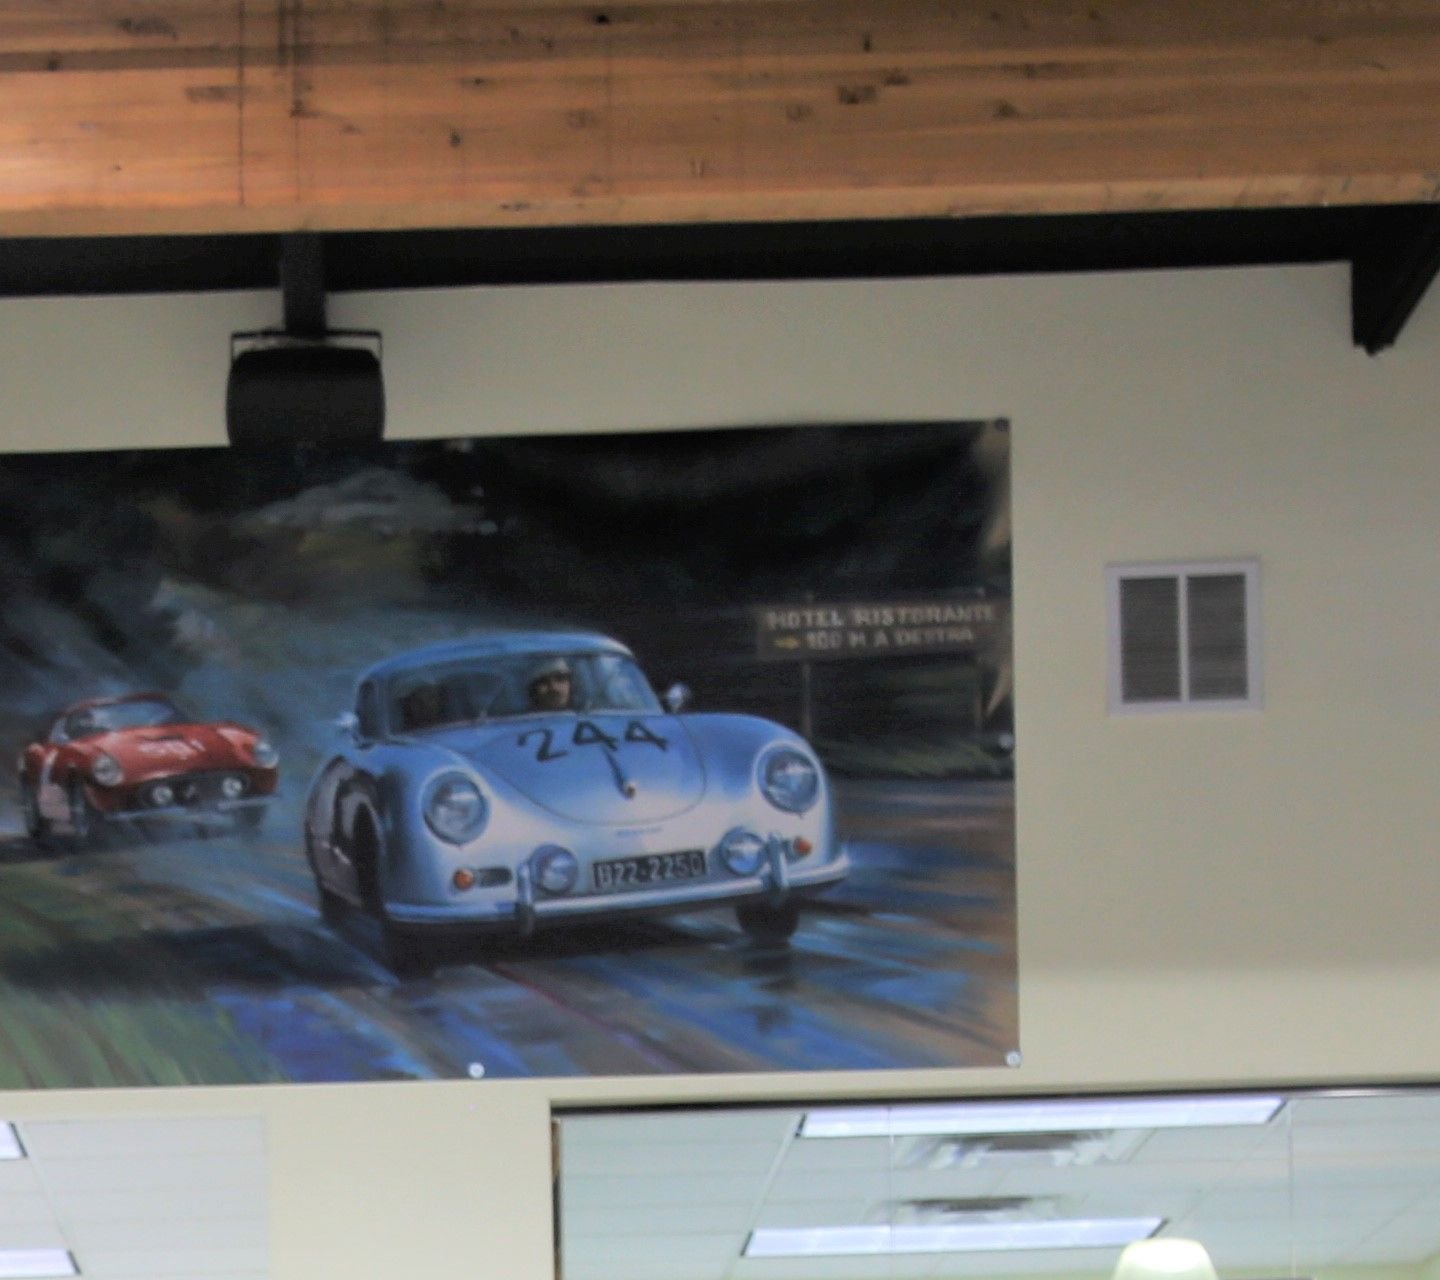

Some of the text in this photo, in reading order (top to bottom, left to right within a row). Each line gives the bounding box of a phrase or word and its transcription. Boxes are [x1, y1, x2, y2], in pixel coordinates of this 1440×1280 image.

[767, 604, 993, 629] HOTEL RISTORANTE
[517, 720, 667, 762] 244
